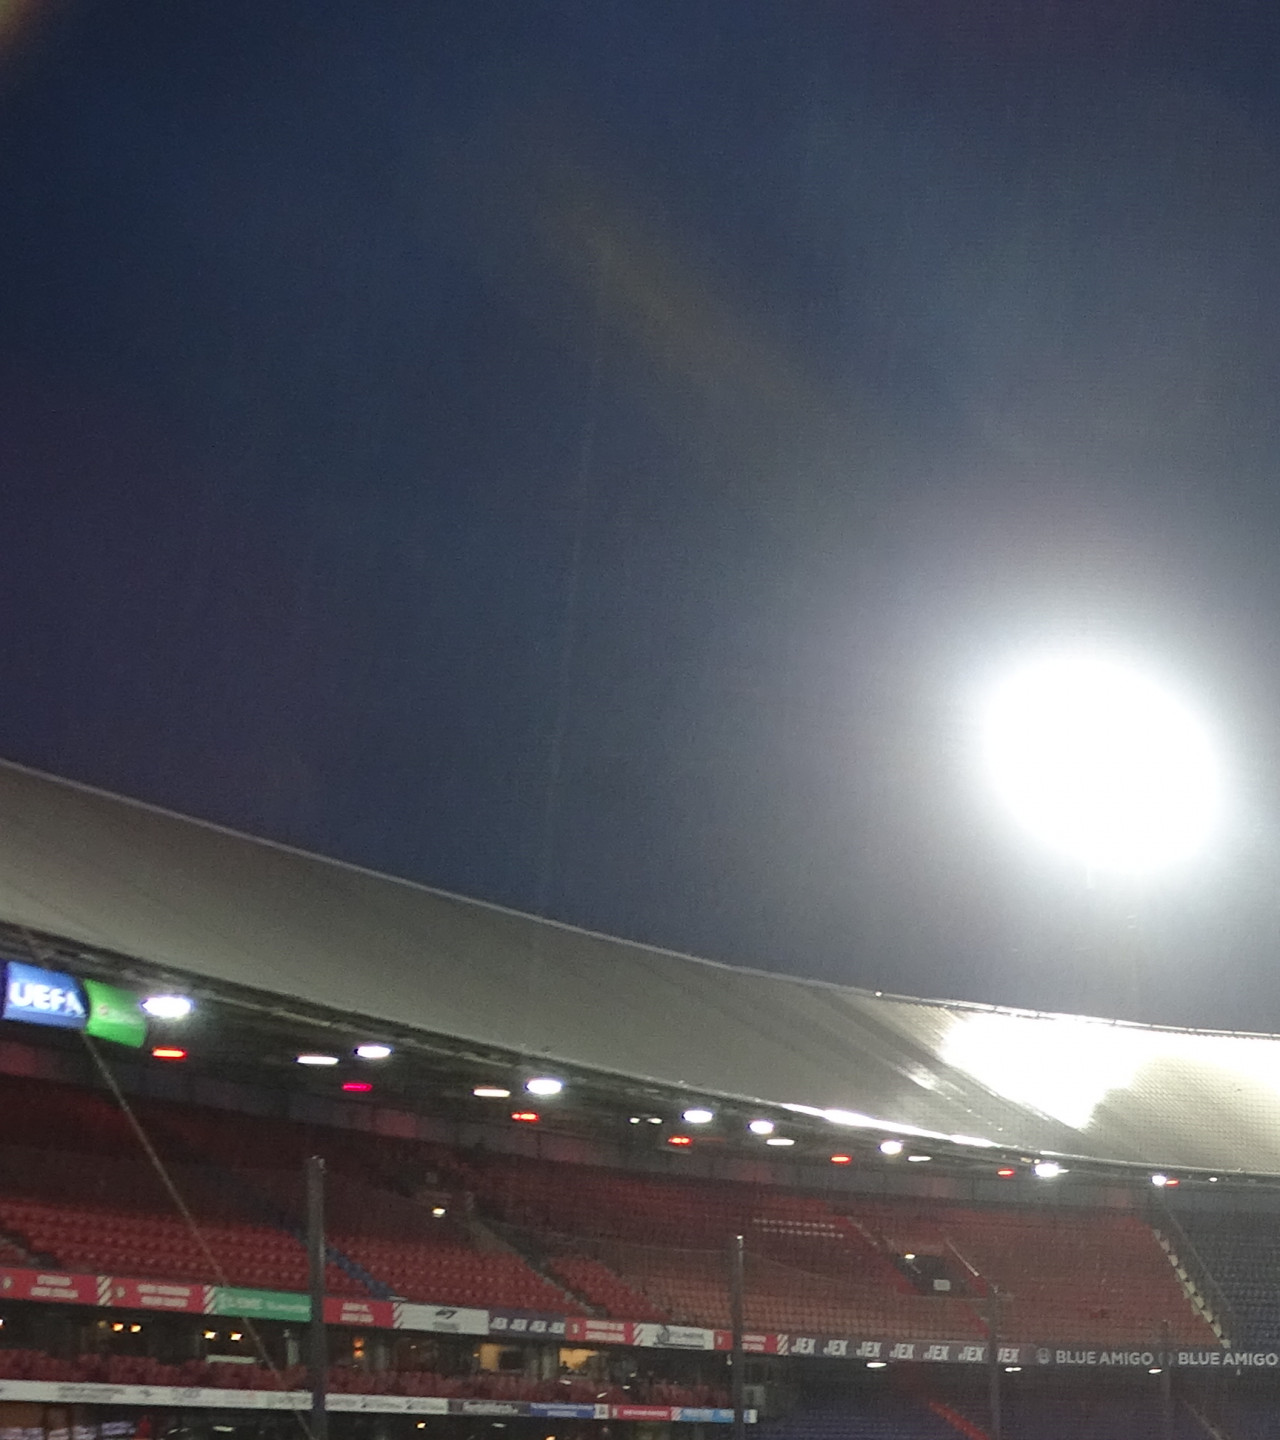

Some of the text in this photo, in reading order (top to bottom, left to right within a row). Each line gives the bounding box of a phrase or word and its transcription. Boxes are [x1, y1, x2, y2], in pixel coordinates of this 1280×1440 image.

[9, 981, 85, 1016] UEFA
[1056, 1350, 1154, 1366] BLUE AMIGO
[1178, 1352, 1278, 1366] BLUE AMIGO
